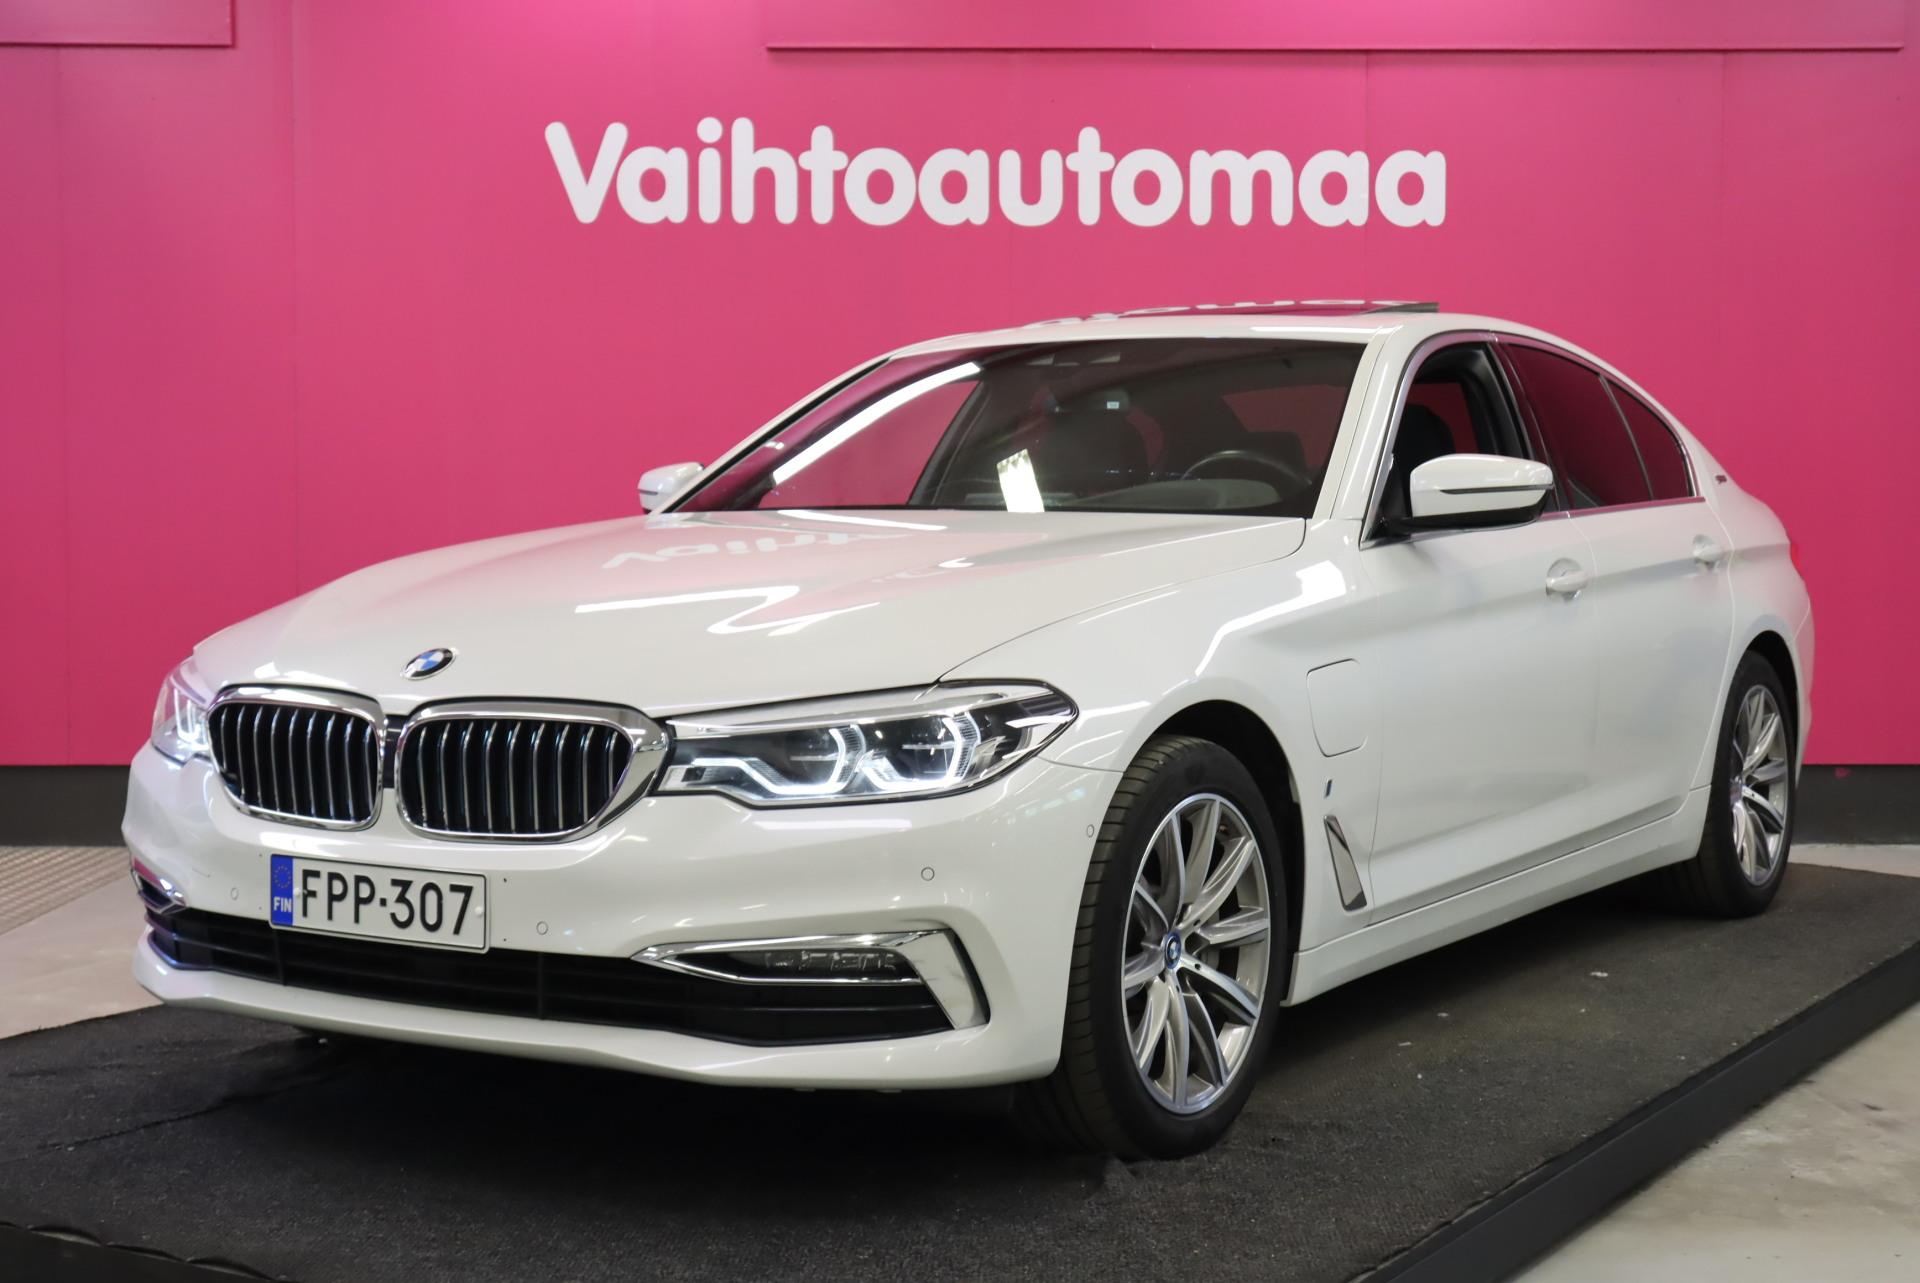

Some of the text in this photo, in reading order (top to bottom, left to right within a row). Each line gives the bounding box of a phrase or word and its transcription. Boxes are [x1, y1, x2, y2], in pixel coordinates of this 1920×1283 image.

[544, 117, 1447, 227] Vaihtoautomaa
[273, 869, 474, 935] FIN FPP-307
